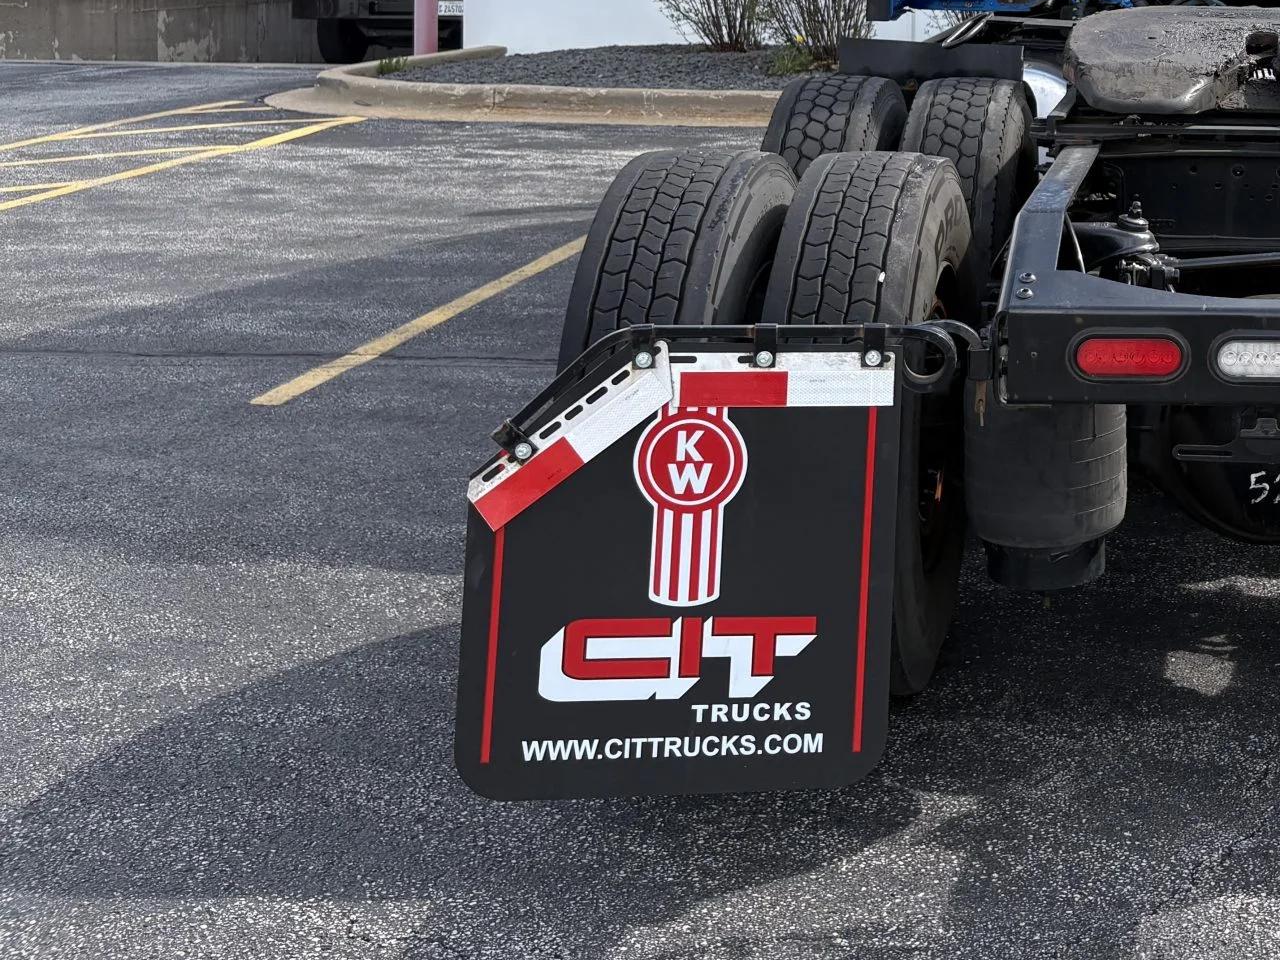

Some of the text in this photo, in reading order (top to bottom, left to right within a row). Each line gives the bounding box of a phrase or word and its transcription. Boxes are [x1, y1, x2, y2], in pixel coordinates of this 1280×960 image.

[676, 430, 704, 462] K
[667, 463, 712, 494] W
[538, 616, 818, 701] CIT
[691, 702, 812, 723] TRUCKS
[522, 732, 824, 762] WWW.CITTRUCKS.COM
